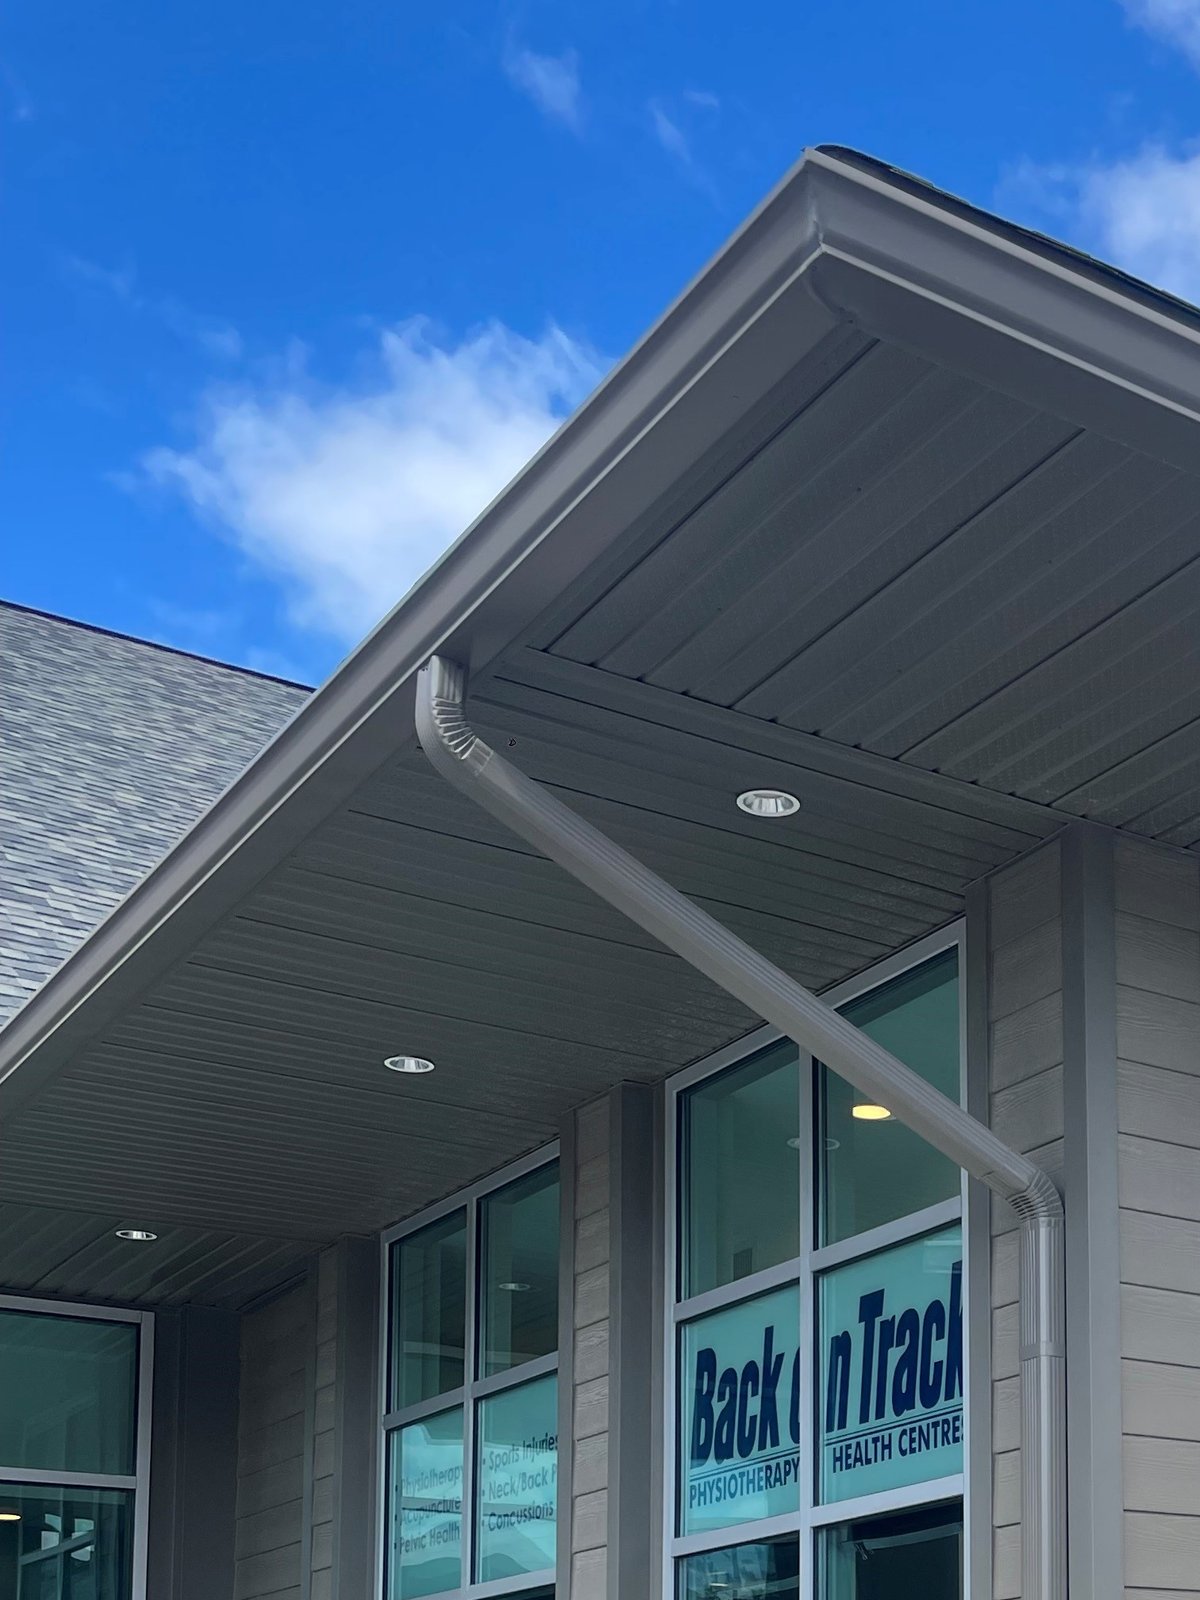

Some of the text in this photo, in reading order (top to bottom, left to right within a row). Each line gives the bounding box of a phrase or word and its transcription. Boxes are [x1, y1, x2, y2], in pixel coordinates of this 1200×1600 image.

[690, 1326, 785, 1469] Back
[488, 1443, 520, 1474] Sports
[689, 1456, 800, 1509] PHYSIOTHERAPY
[833, 1433, 892, 1473] HEALTH
[488, 1501, 554, 1531] Concussions
